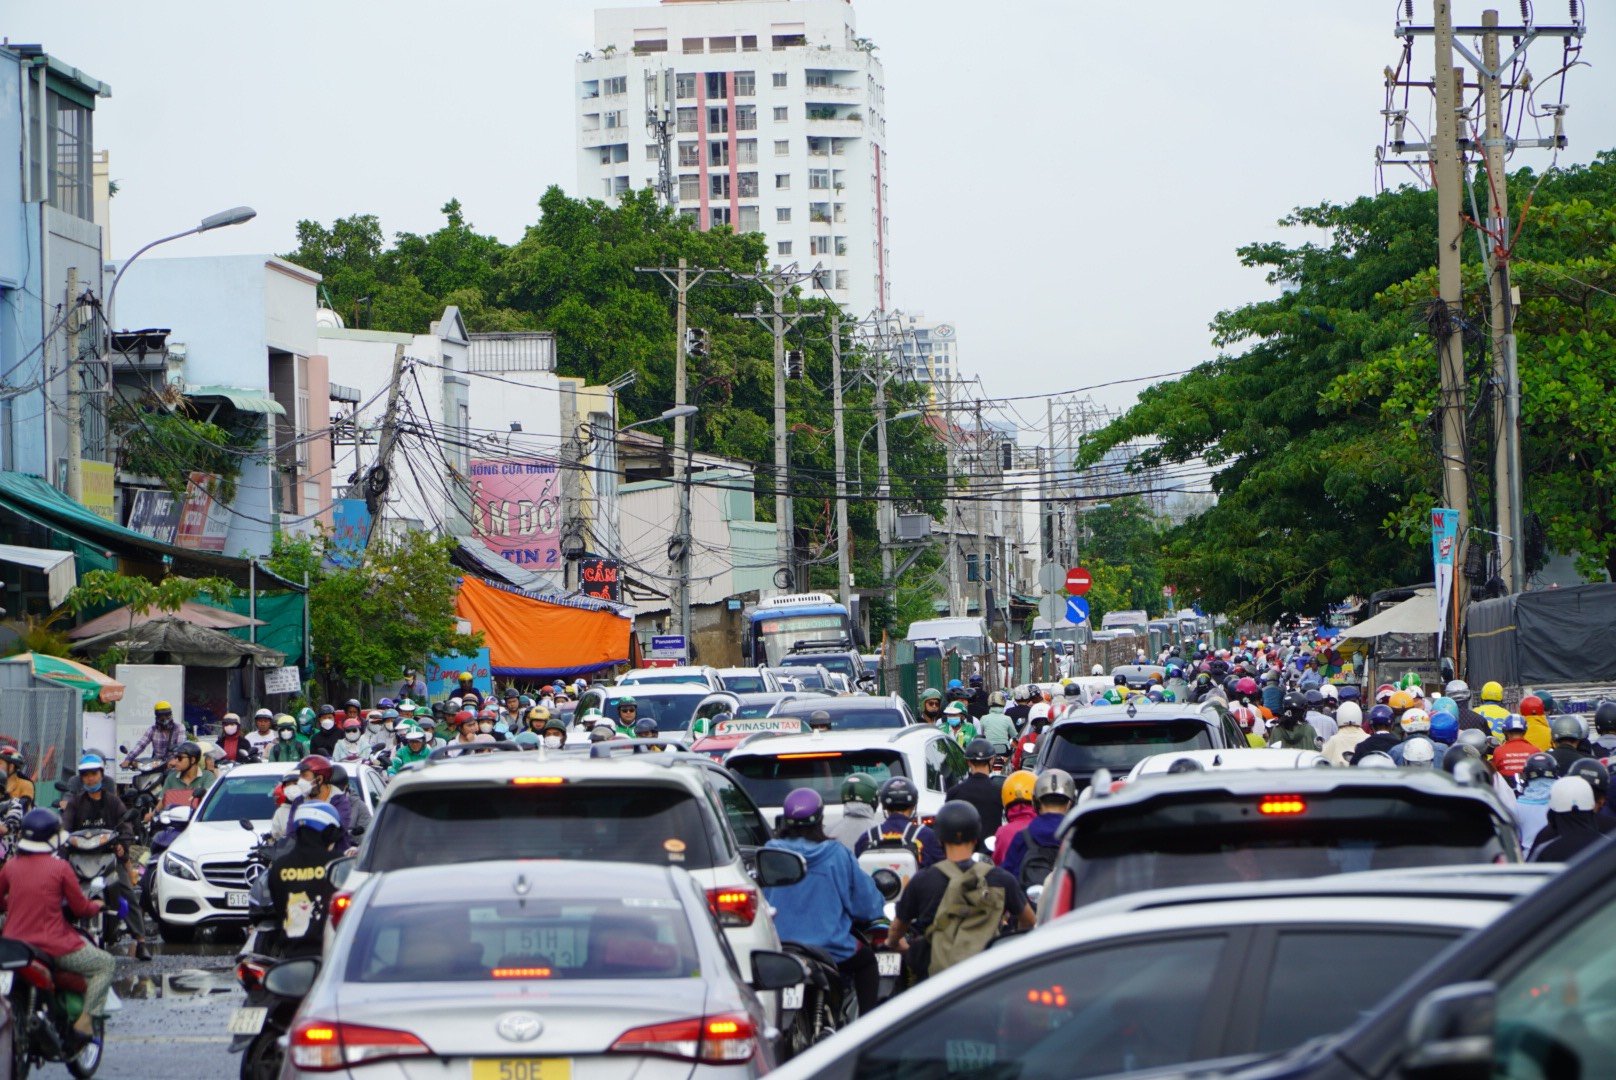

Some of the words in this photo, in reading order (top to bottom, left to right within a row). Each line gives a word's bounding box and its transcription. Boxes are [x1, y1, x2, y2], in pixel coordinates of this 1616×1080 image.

[546, 549, 558, 563] 2
[584, 560, 617, 583] CẦM
[735, 722, 780, 731] VINASUN
[781, 721, 800, 729] TAXI
[279, 865, 326, 882] COMBO
[229, 893, 248, 905] 51G
[499, 1059, 543, 1080] 50E
